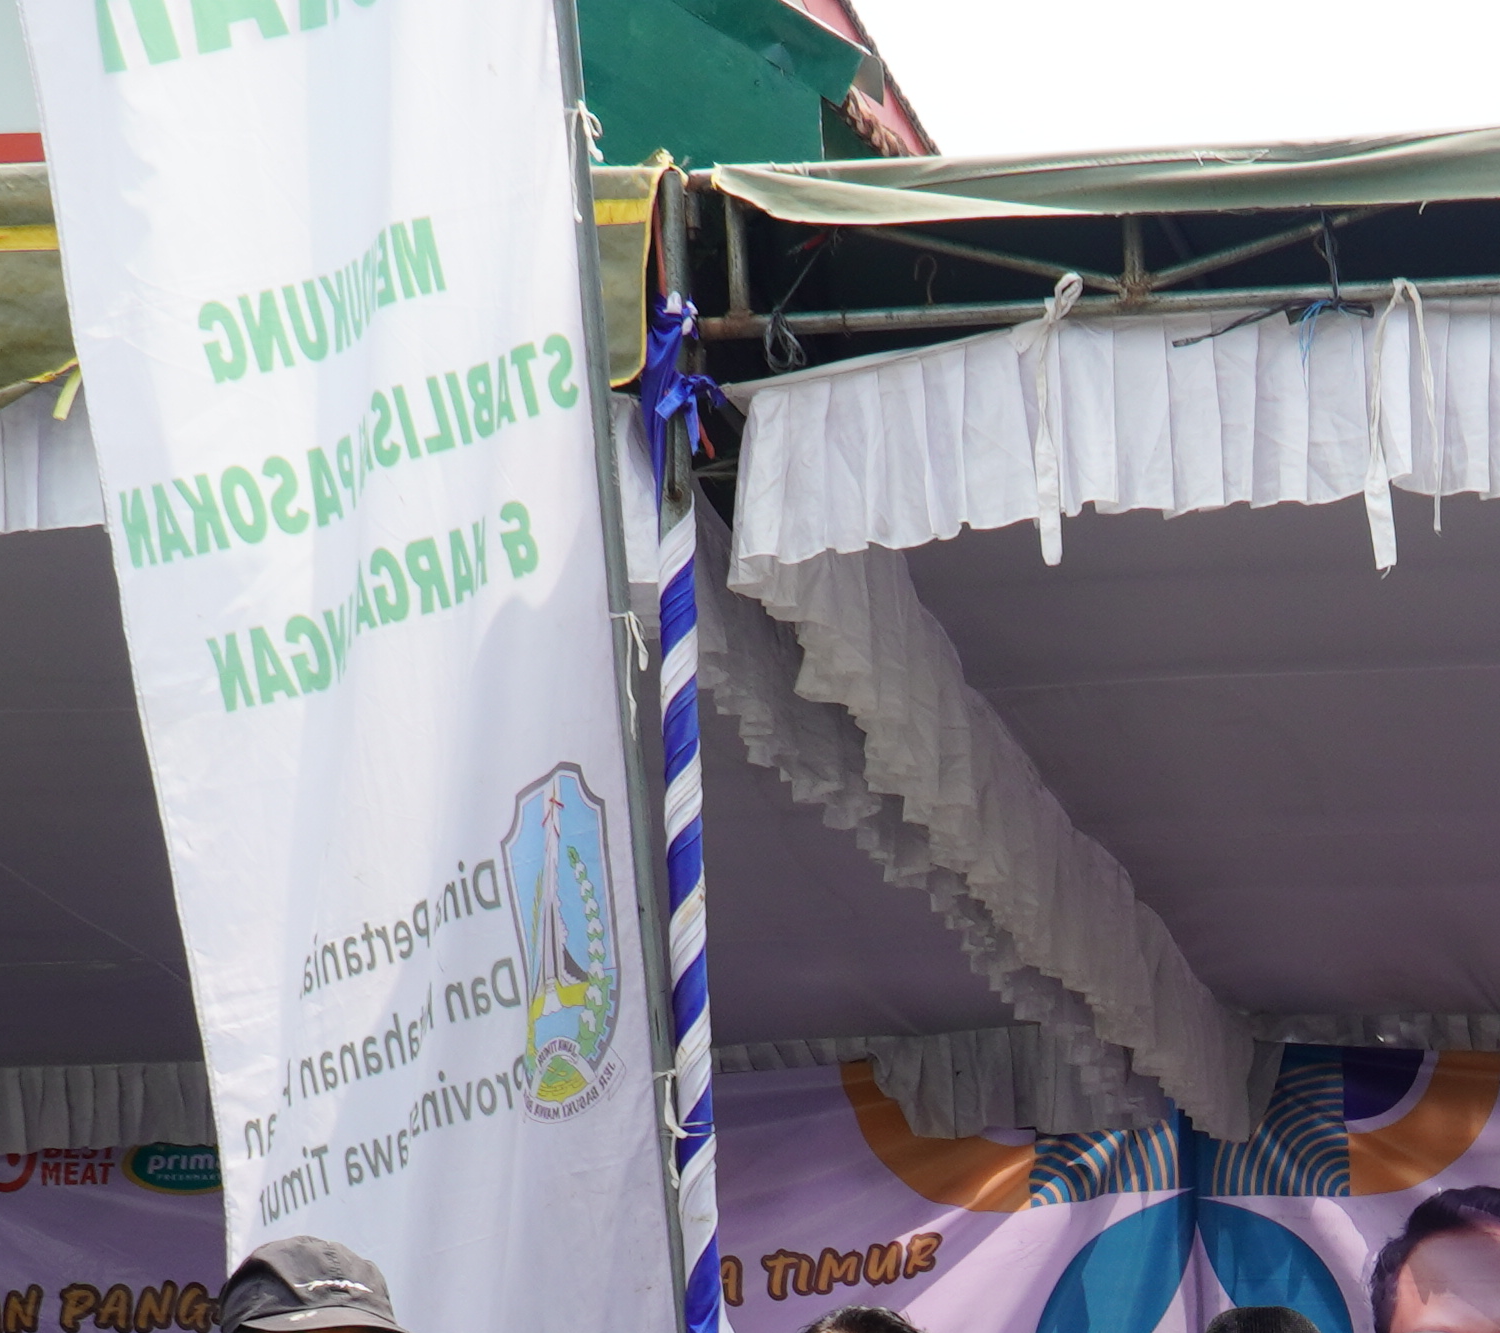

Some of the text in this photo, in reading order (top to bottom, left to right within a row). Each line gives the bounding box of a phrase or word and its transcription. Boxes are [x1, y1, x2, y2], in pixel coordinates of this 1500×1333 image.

[41, 1162, 116, 1186] MEAT
[147, 1152, 218, 1175] prim
[760, 1232, 943, 1302] TIMUR
